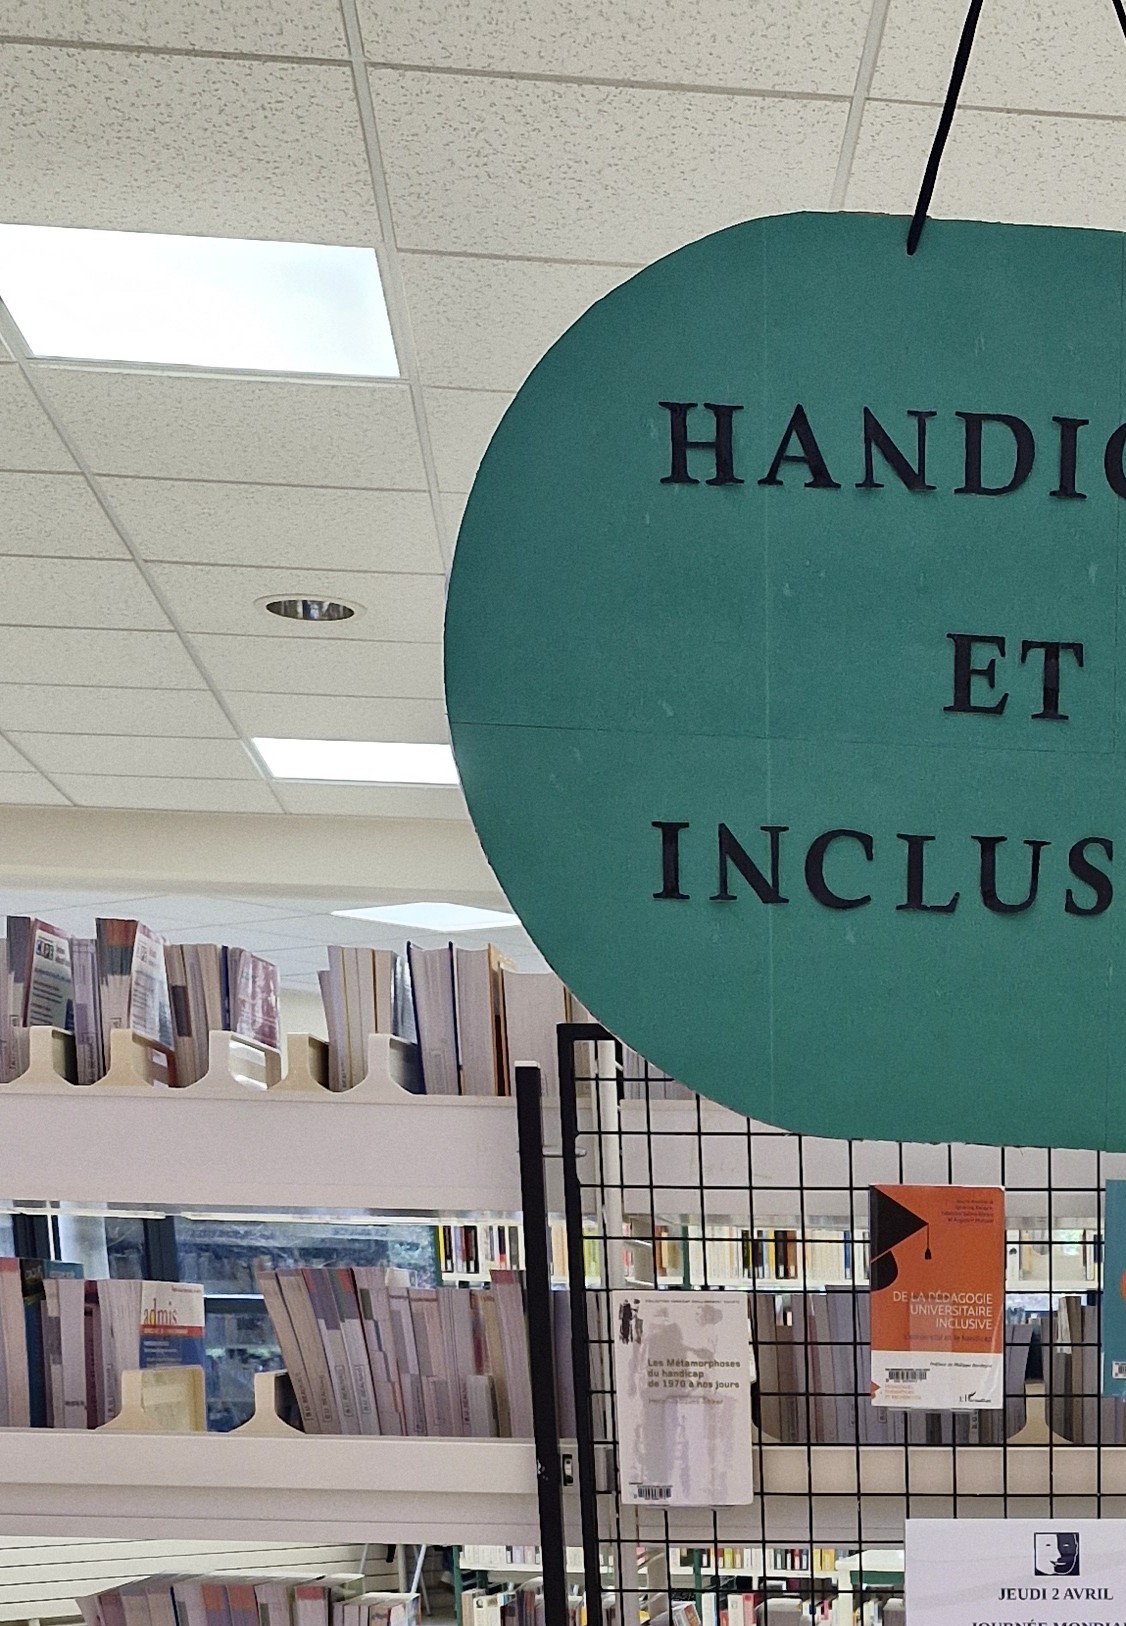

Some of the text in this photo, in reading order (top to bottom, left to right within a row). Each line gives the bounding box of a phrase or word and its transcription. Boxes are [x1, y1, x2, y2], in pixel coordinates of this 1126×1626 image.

[943, 633, 1084, 720] ET
[893, 1290, 993, 1304] DE LA PÉDAGOGIE
[144, 1298, 177, 1327] admis
[910, 1305, 993, 1317] UNIVERSITAIRE
[936, 1317, 993, 1330] INCLUSIVE
[648, 1359, 740, 1368] Les Métamorphoses
[662, 1369, 704, 1378] handicap
[716, 1380, 739, 1389] jours
[998, 1588, 1114, 1602] JEUDI 2 AVRIL
